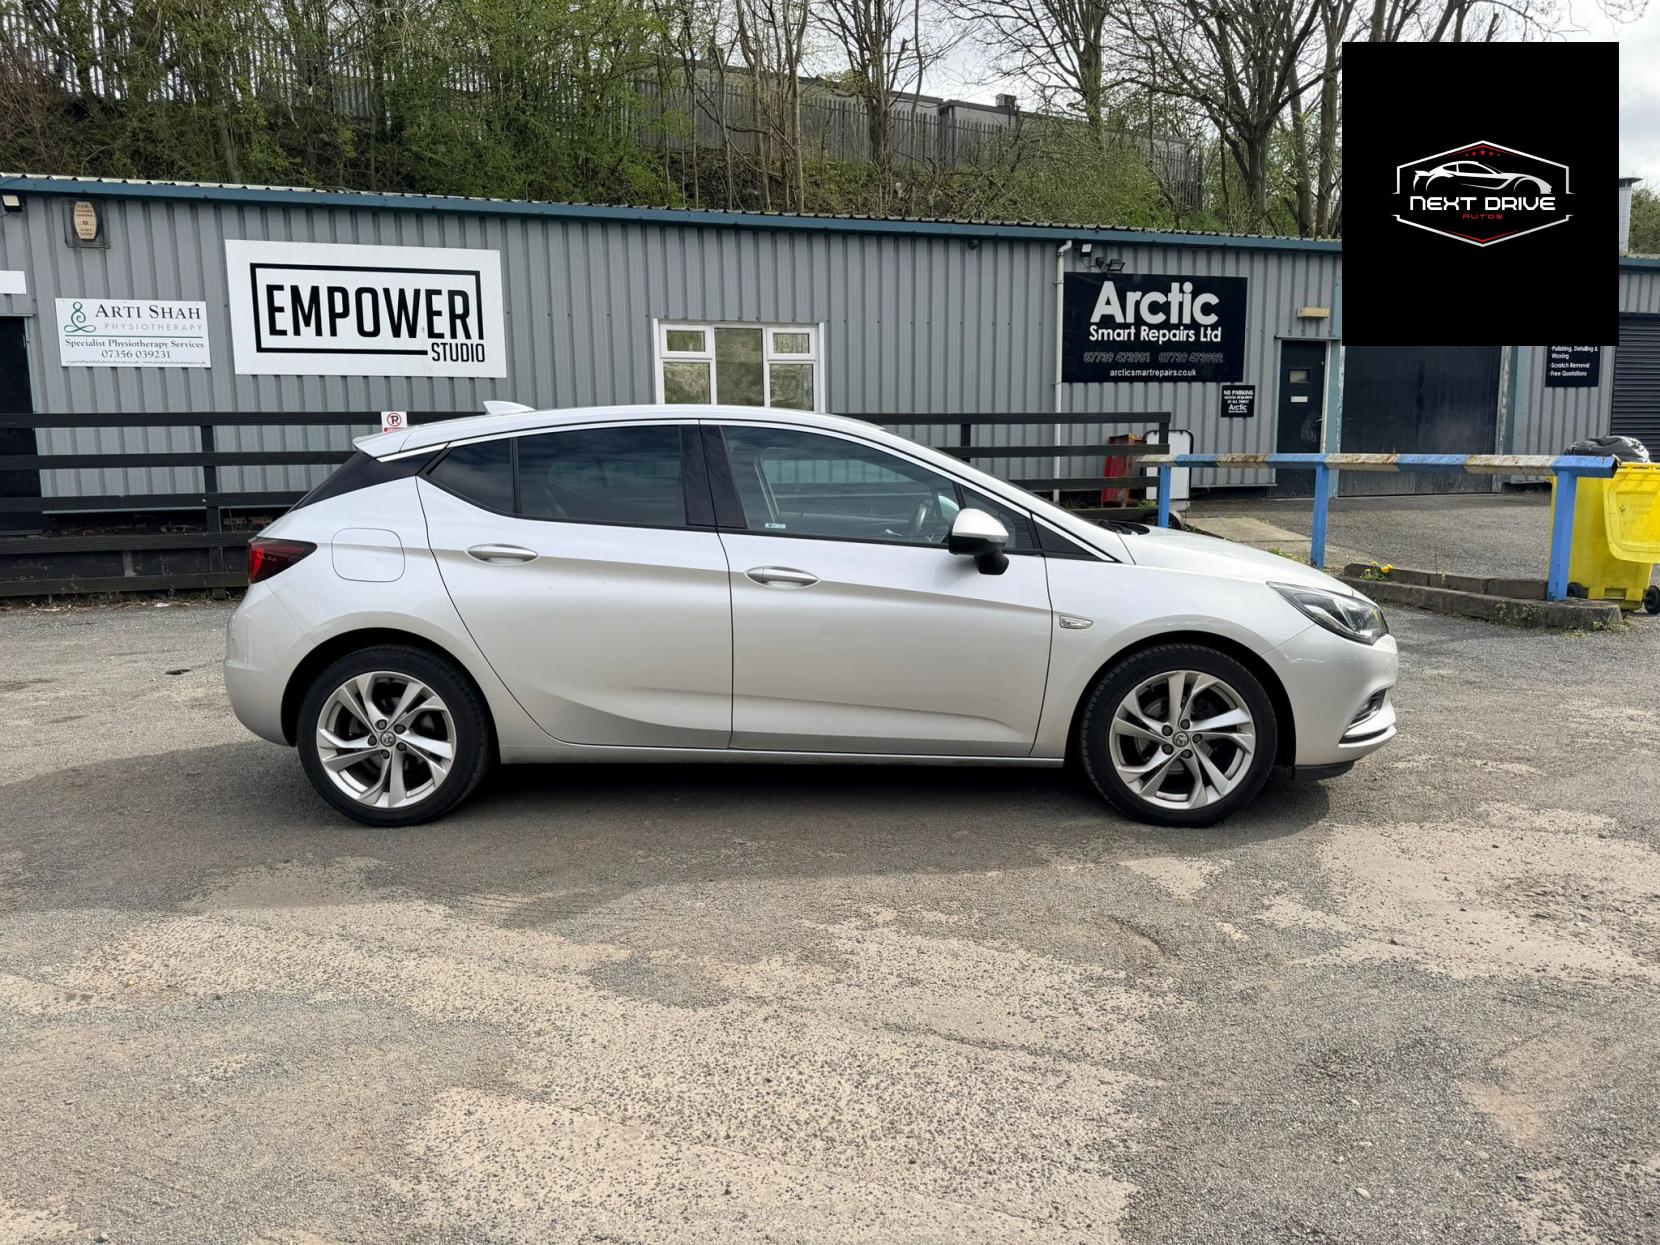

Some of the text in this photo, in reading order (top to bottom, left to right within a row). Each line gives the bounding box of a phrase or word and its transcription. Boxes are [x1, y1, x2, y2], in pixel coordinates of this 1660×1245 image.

[1090, 280, 1220, 326] Arctic
[95, 304, 202, 320] ARTI SHAH
[265, 284, 472, 340] EMPOWER
[104, 322, 203, 331] PHYSIOTHERAPY
[1089, 324, 1222, 345] Smart Repairs Ltd
[65, 338, 205, 350] Specialist Physiotherapy Services
[101, 350, 171, 359] 07356 039231
[431, 342, 486, 363] STUDIO
[1110, 368, 1197, 378] arcticsmartrepairs.co.uk
